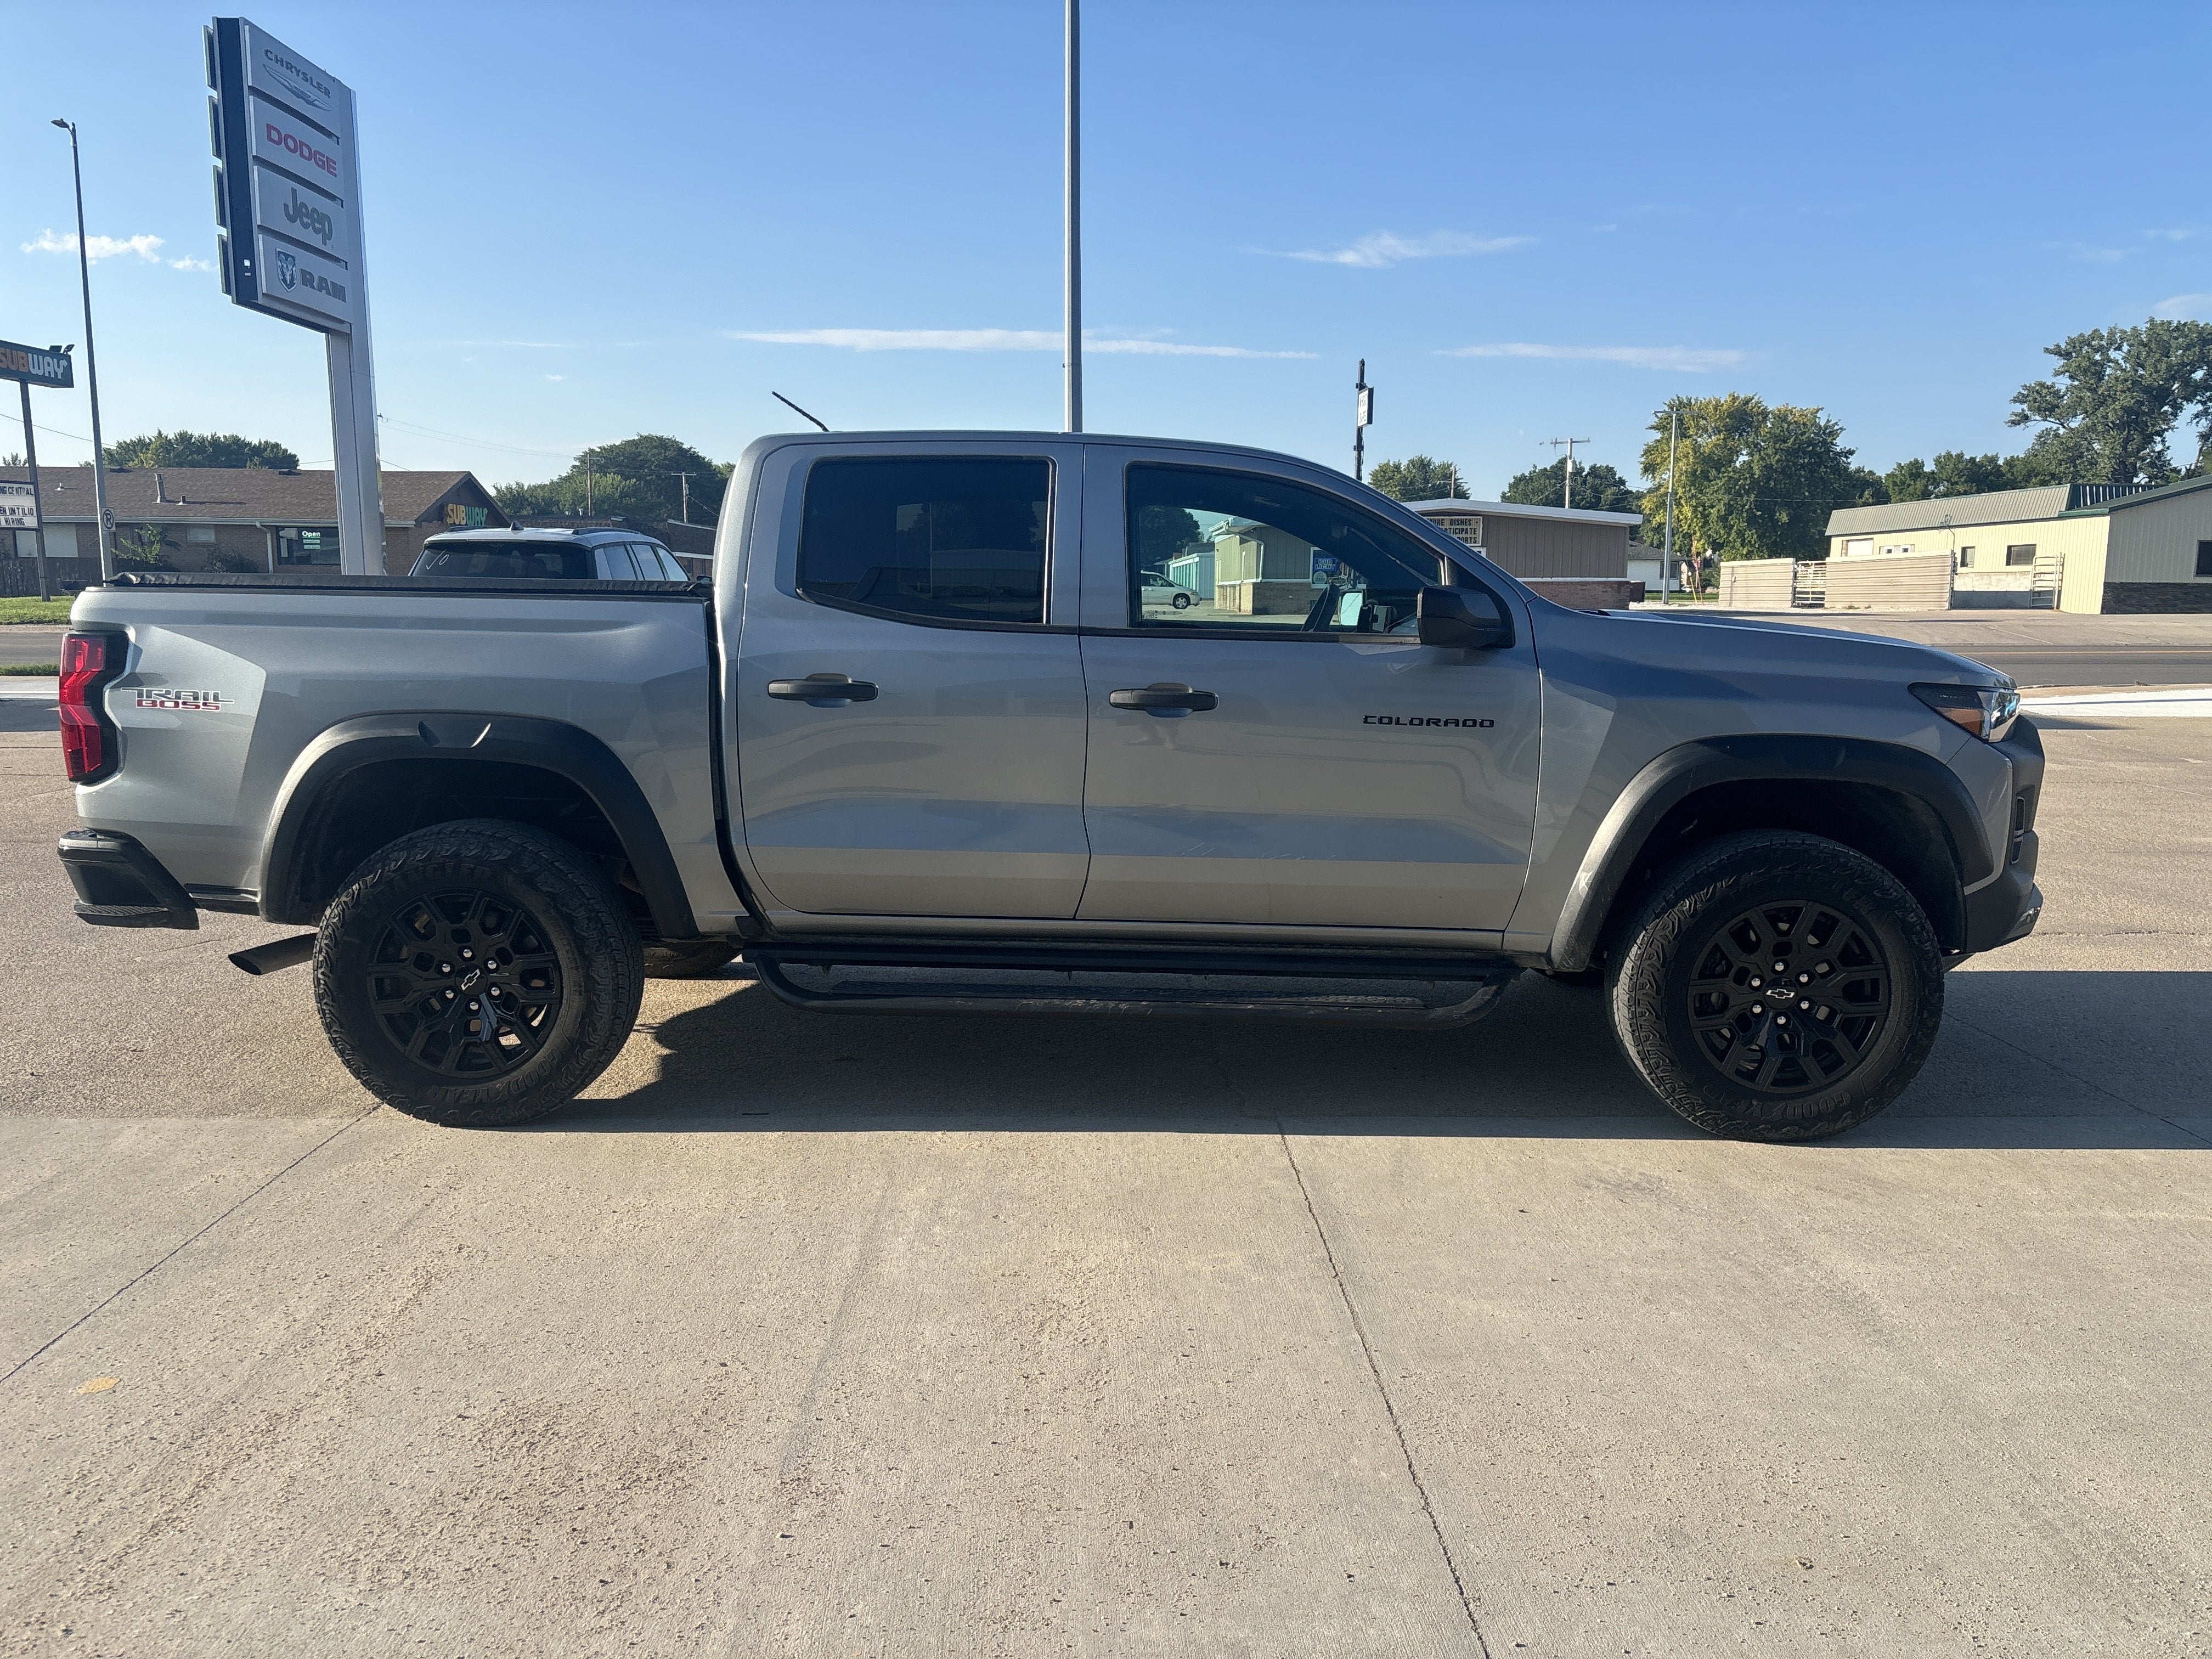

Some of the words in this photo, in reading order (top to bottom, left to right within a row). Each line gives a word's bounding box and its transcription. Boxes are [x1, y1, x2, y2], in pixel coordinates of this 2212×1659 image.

[263, 48, 331, 99] CHRYSLER
[266, 123, 337, 178] DODGE
[283, 187, 333, 246] Jeep
[299, 268, 347, 303] RAM
[0, 347, 68, 379] SUBWAY
[4, 517, 25, 526] HIRING
[447, 503, 488, 527] SUBWAY
[121, 687, 235, 704] TRAIL
[136, 699, 221, 712] BOSS
[1363, 715, 1495, 729] COLORADO
[426, 1047, 563, 1105] GOODYEAR
